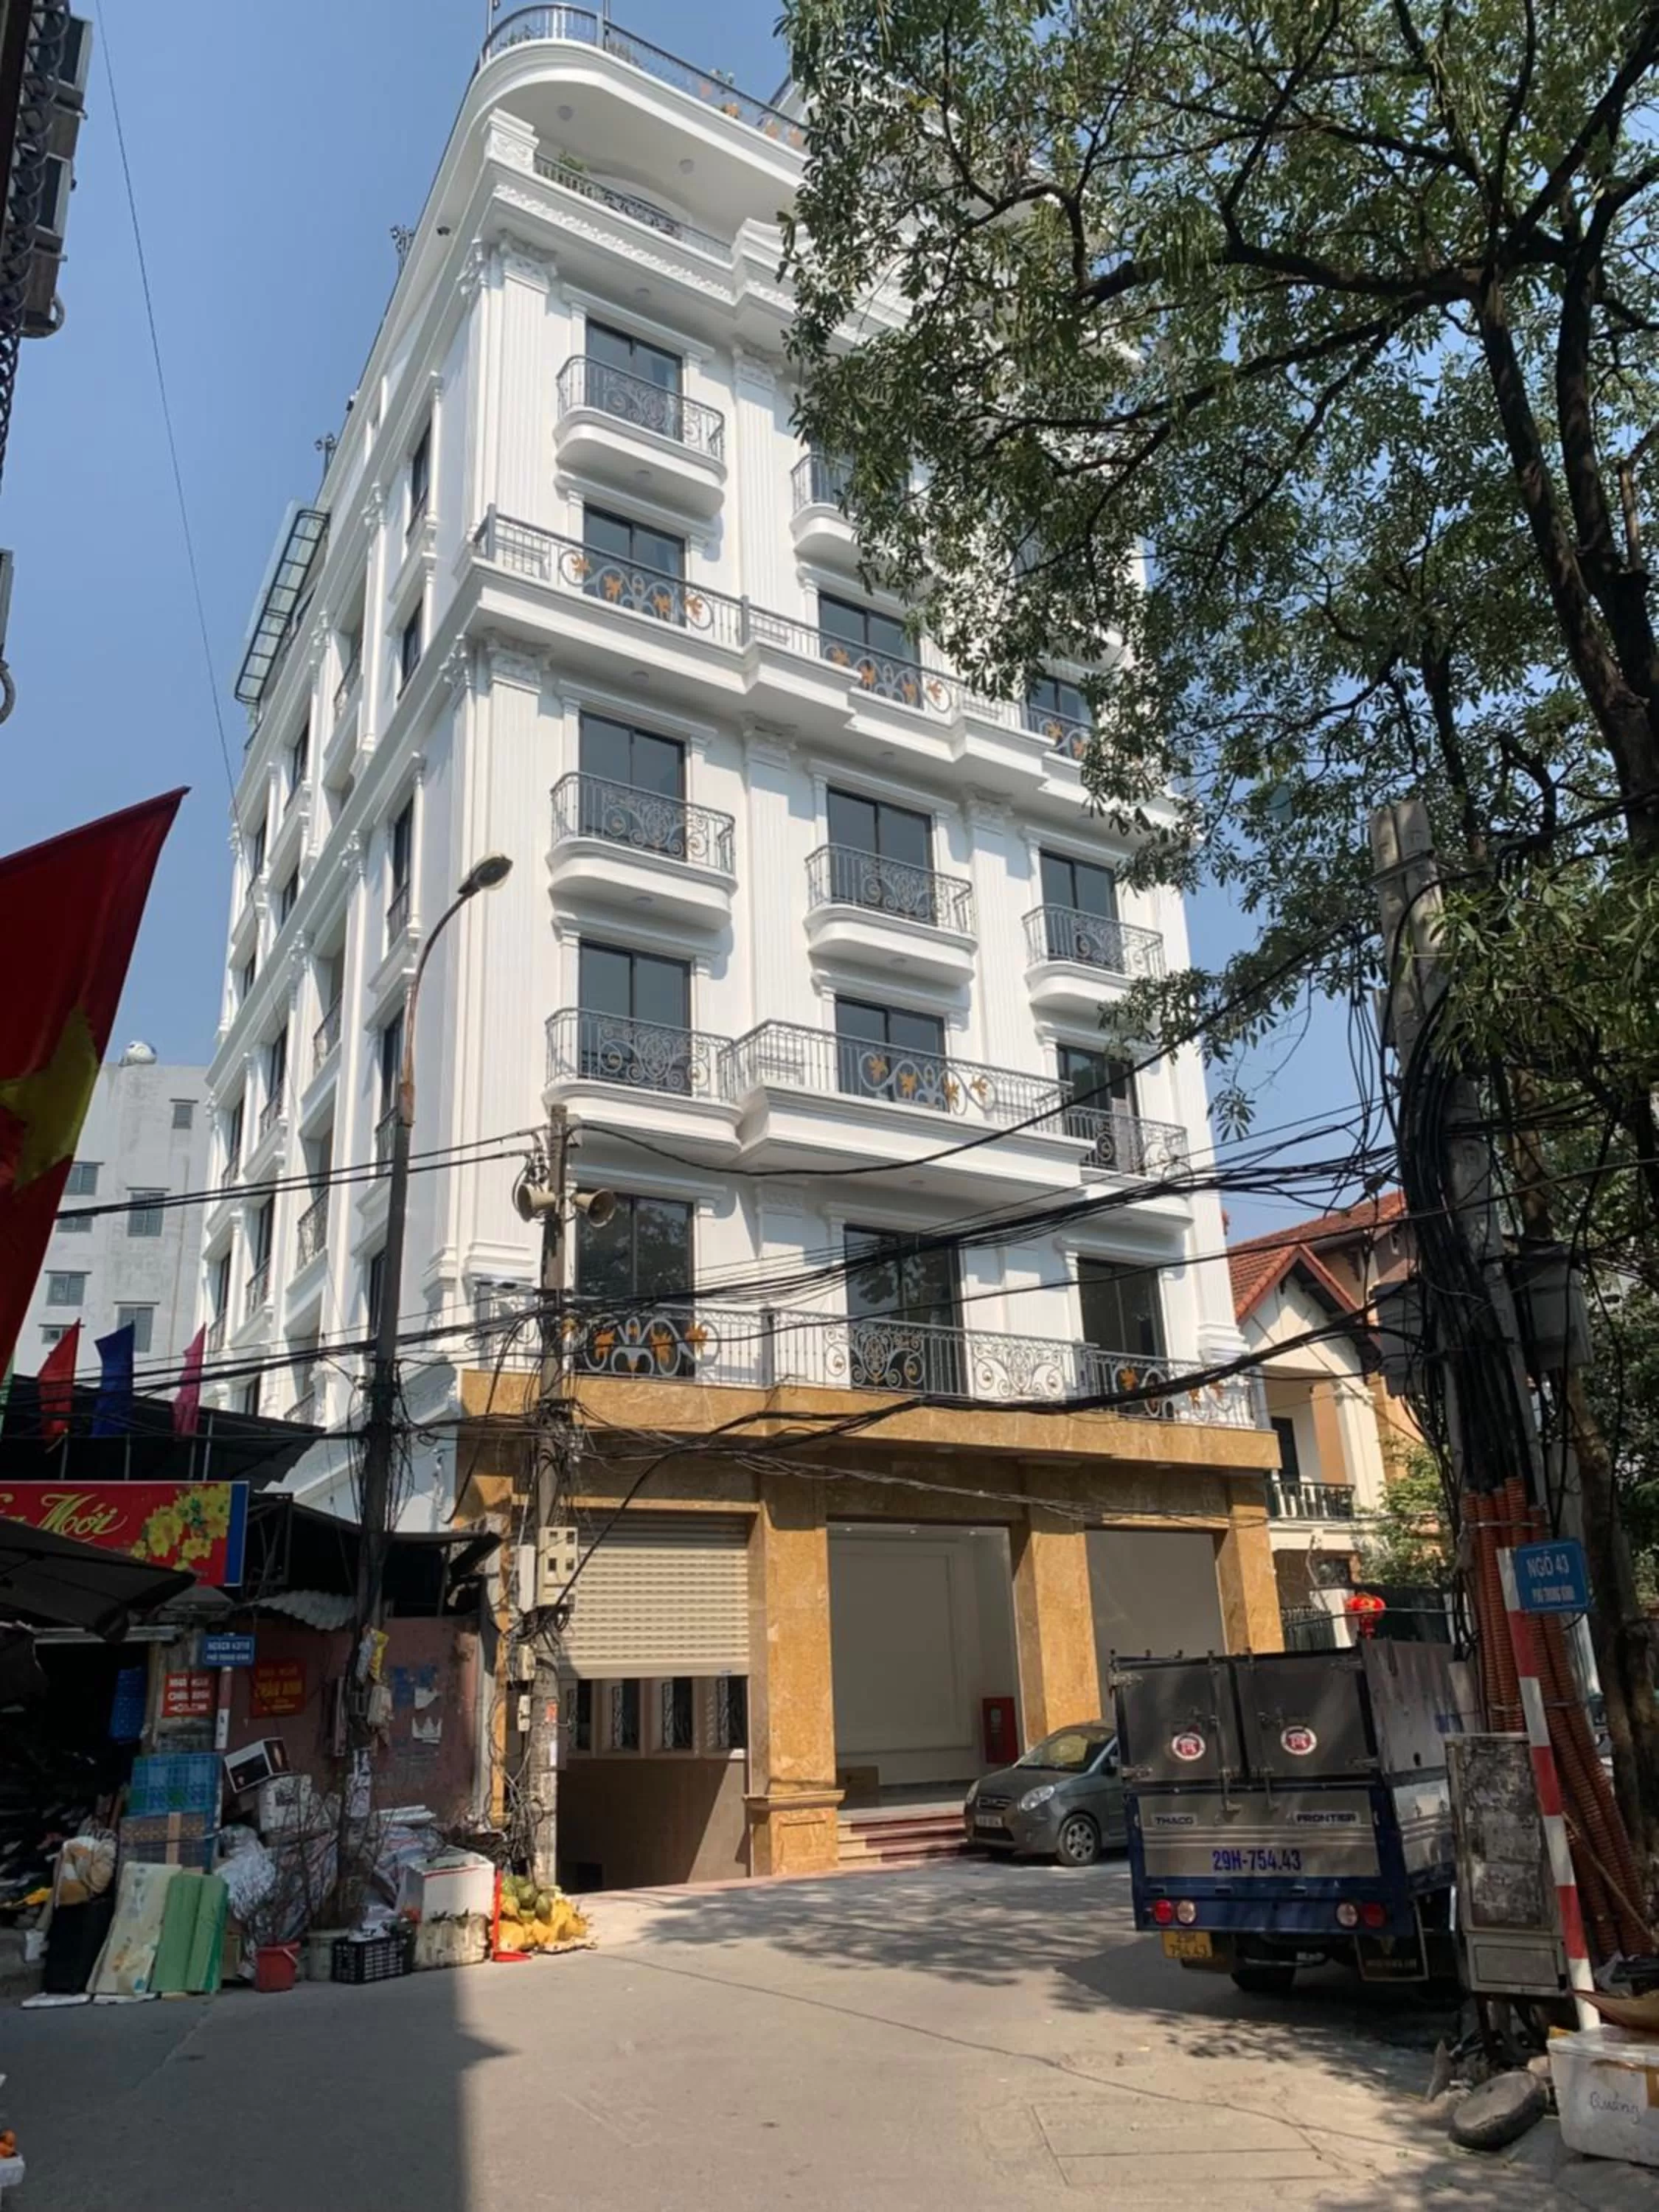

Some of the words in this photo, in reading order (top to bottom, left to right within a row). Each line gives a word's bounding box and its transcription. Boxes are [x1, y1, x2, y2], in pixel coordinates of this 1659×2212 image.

[1155, 1816, 1194, 1825] THACO
[1295, 1812, 1357, 1823] FRONTIER
[1212, 1848, 1302, 1871] 29H-754.43
